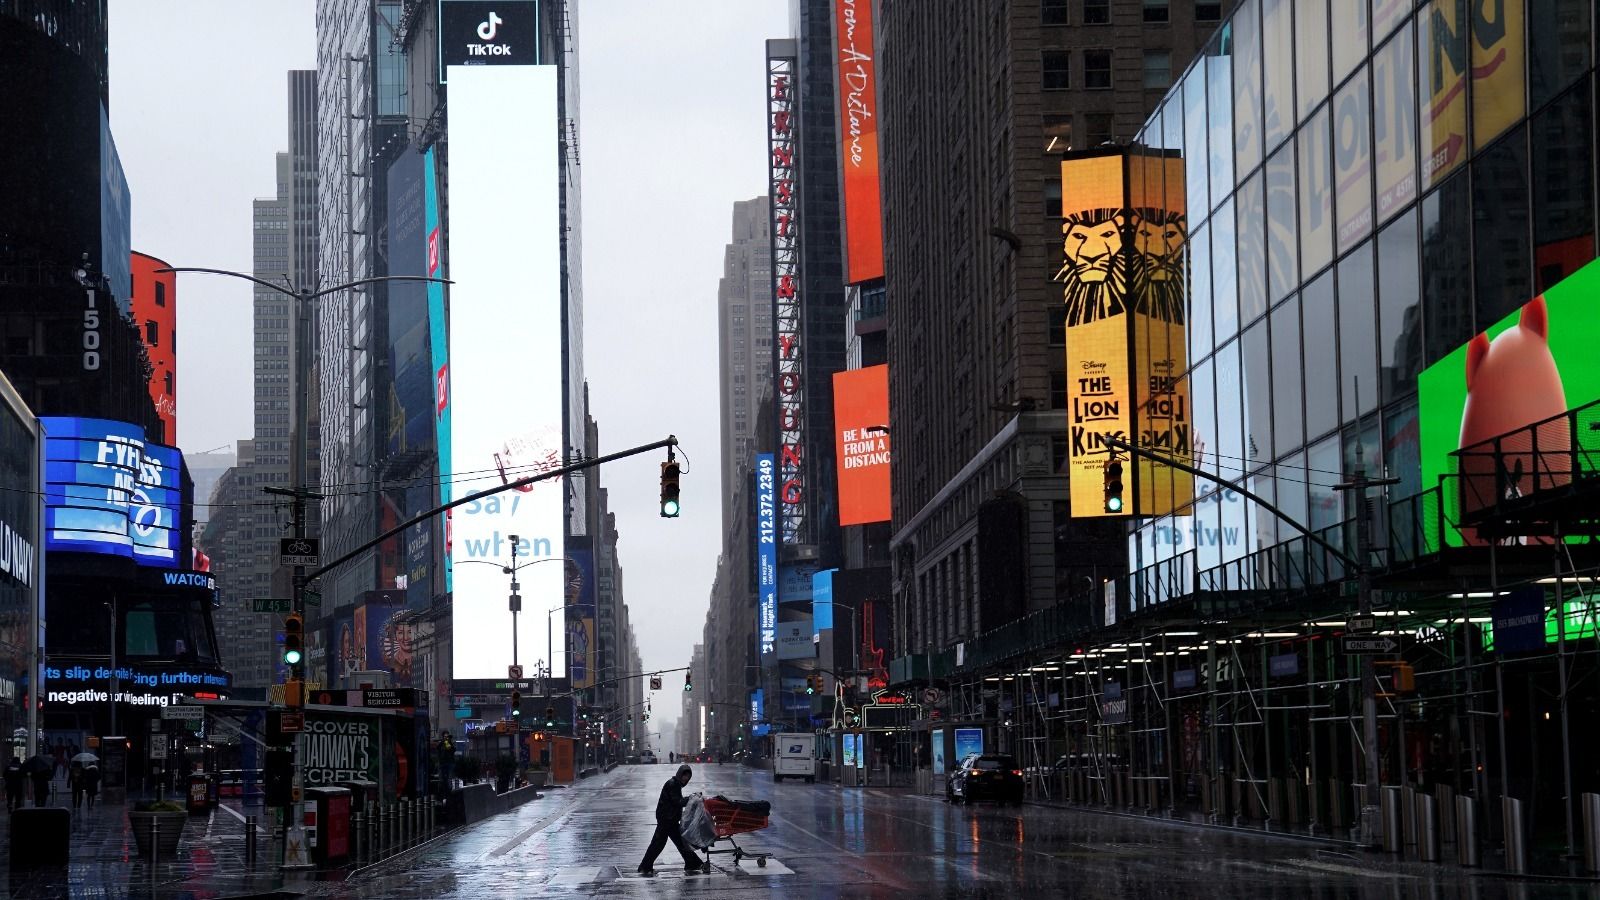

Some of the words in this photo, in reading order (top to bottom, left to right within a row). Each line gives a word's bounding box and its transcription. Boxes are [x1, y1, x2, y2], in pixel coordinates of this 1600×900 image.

[844, 0, 856, 40] rom
[466, 44, 512, 56] TikTok
[845, 65, 872, 168] Distance
[774, 76, 792, 237] ERNST
[1340, 206, 1372, 242] ENTRANC
[1380, 194, 1392, 210] ON
[1396, 177, 1414, 198] 45TH
[1423, 147, 1449, 178] STREET
[777, 275, 796, 298] &
[83, 289, 100, 371] 1500
[1080, 360, 1107, 370] Disney
[1078, 376, 1111, 392] THE
[779, 335, 802, 504] YOUNG
[1074, 398, 1118, 423] LION
[843, 429, 858, 442] BE
[844, 440, 874, 456] FROM
[878, 438, 886, 451] A
[844, 450, 890, 469] DISTANC
[760, 459, 774, 544] 212.372.2349
[465, 530, 551, 557] when
[12, 530, 34, 588] NAVY
[164, 572, 207, 586] WATCH
[1383, 591, 1392, 602] W
[256, 600, 264, 611] W
[268, 600, 280, 612] 45
[1508, 614, 1539, 627] BROADWAY
[65, 666, 91, 681] slip
[161, 672, 202, 684] further
[48, 689, 108, 704] negative
[1108, 700, 1126, 715] TISSOT
[304, 719, 369, 734] SCOVER
